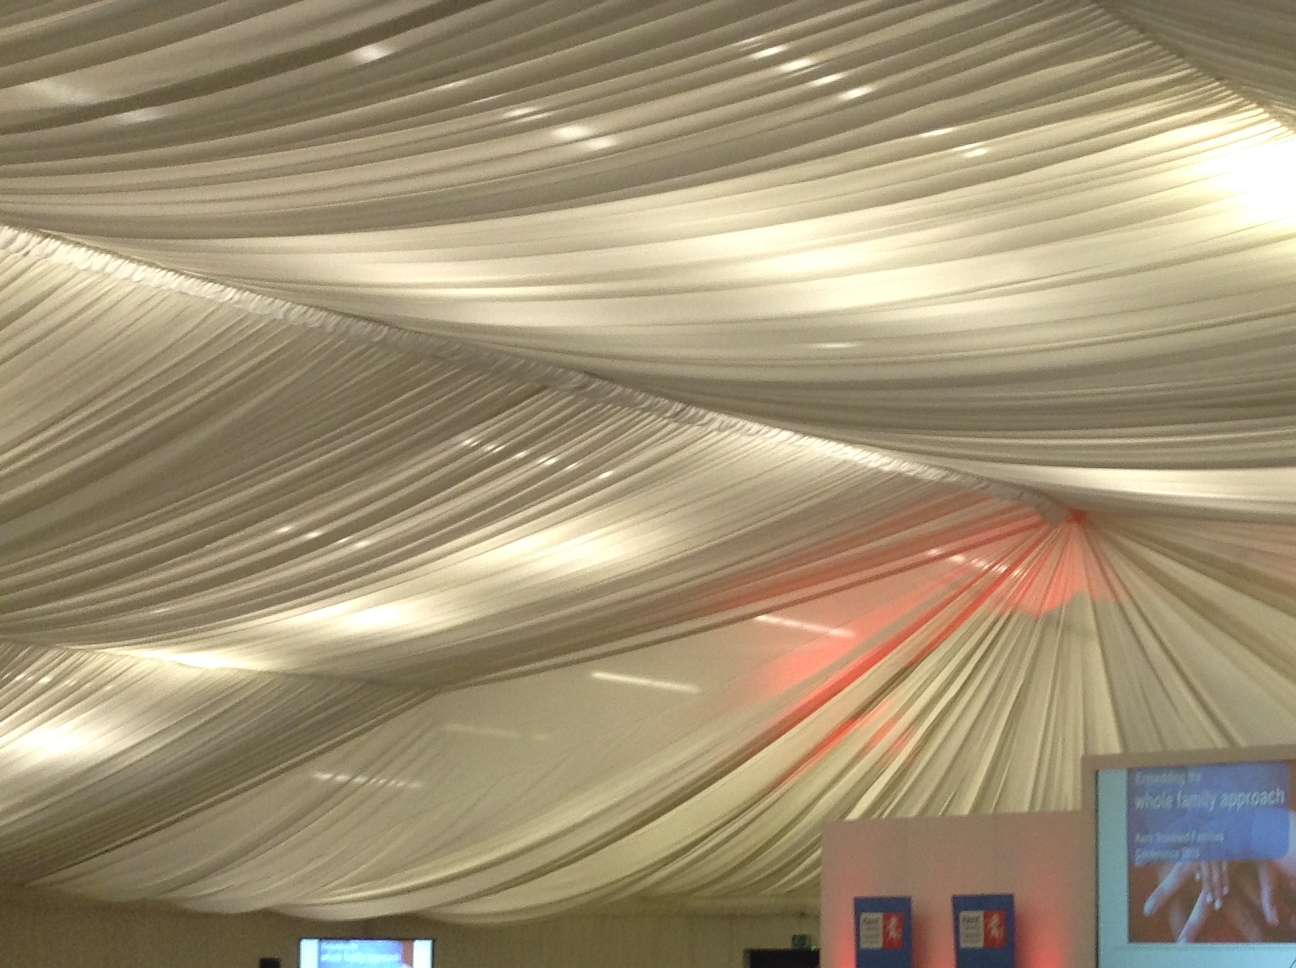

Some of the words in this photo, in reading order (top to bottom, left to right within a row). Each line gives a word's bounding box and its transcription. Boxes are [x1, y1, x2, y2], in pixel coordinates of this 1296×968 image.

[1135, 792, 1173, 809] whole
[1176, 789, 1217, 813] family
[1220, 787, 1285, 811] approach
